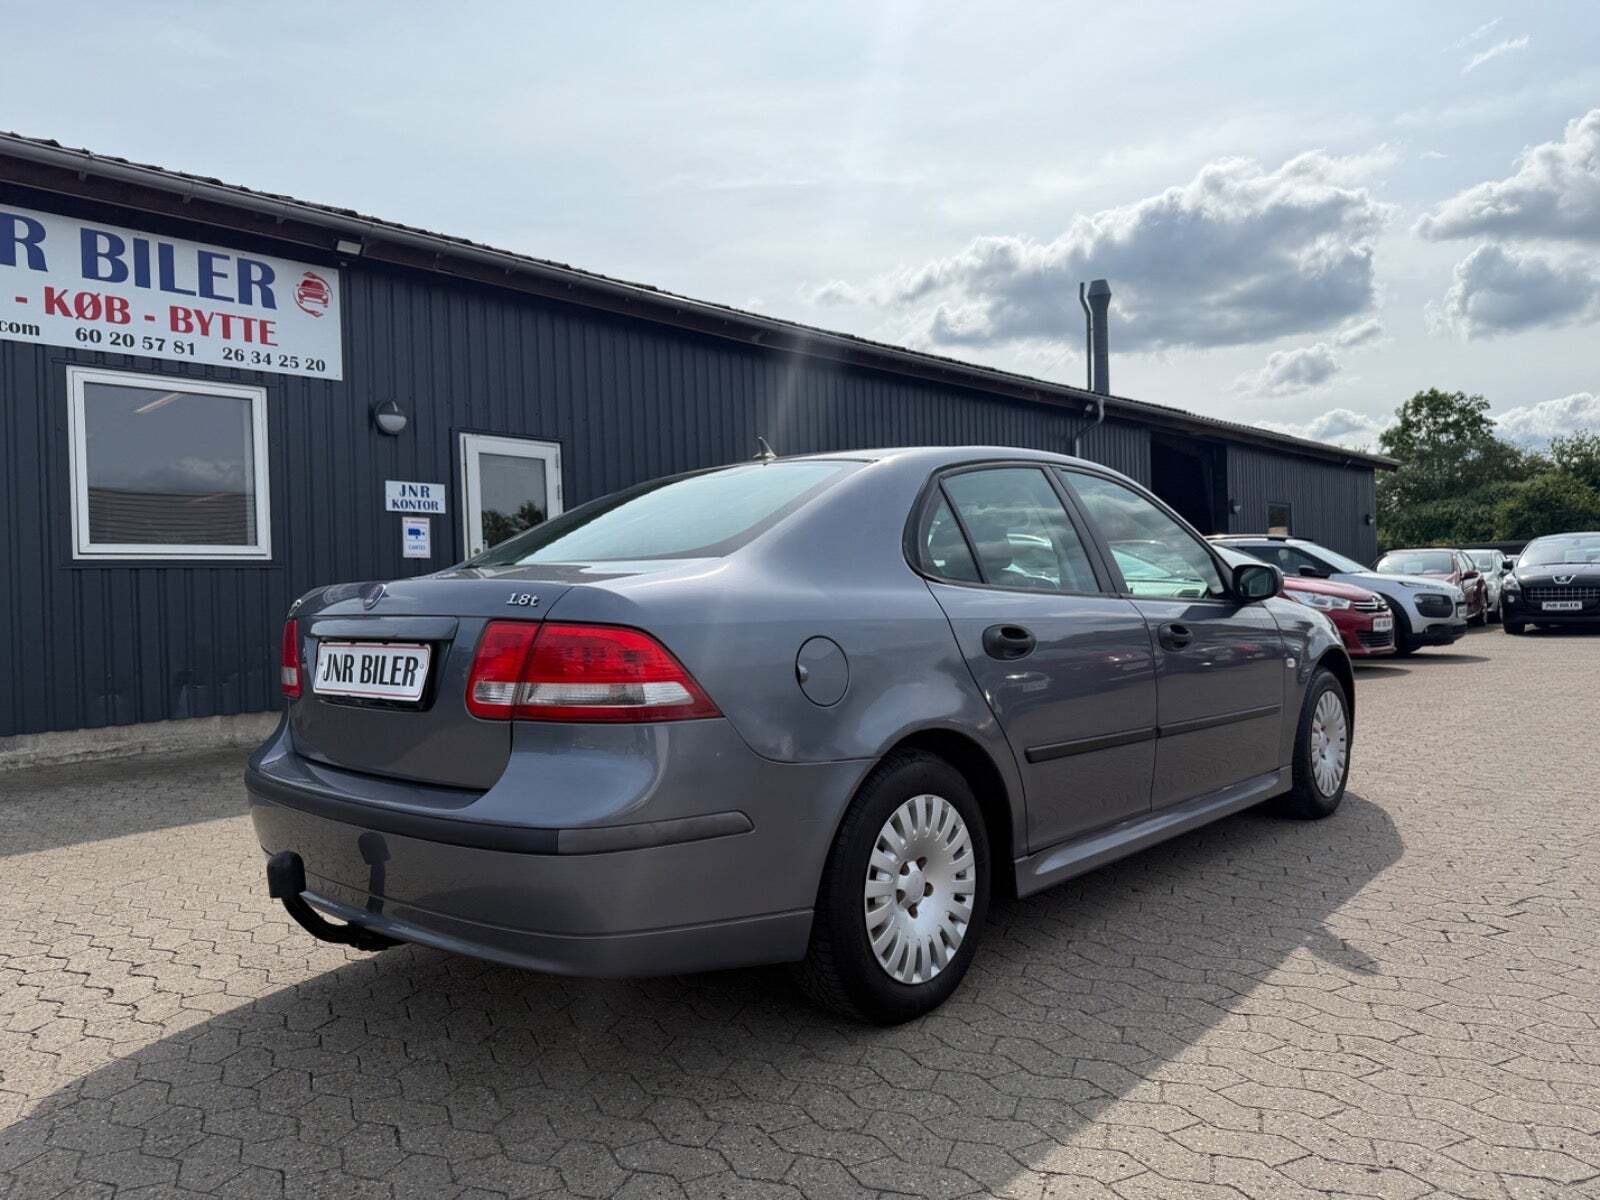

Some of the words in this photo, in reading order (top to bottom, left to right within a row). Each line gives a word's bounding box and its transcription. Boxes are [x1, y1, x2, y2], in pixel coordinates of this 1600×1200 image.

[0, 211, 48, 272] R
[80, 227, 278, 310] BILER
[44, 286, 132, 325] KØB
[169, 305, 279, 347] BYTTE
[75, 327, 102, 344] 60
[109, 331, 135, 348] 20
[142, 336, 166, 352] 57
[173, 340, 196, 356] 81
[222, 347, 245, 362] 26
[251, 350, 272, 365] 34
[278, 354, 300, 369] 25
[305, 358, 326, 372] 20
[392, 499, 439, 511] KONTOR
[399, 484, 430, 498] JNR
[323, 653, 355, 683] JNR
[359, 654, 419, 687] BILER
